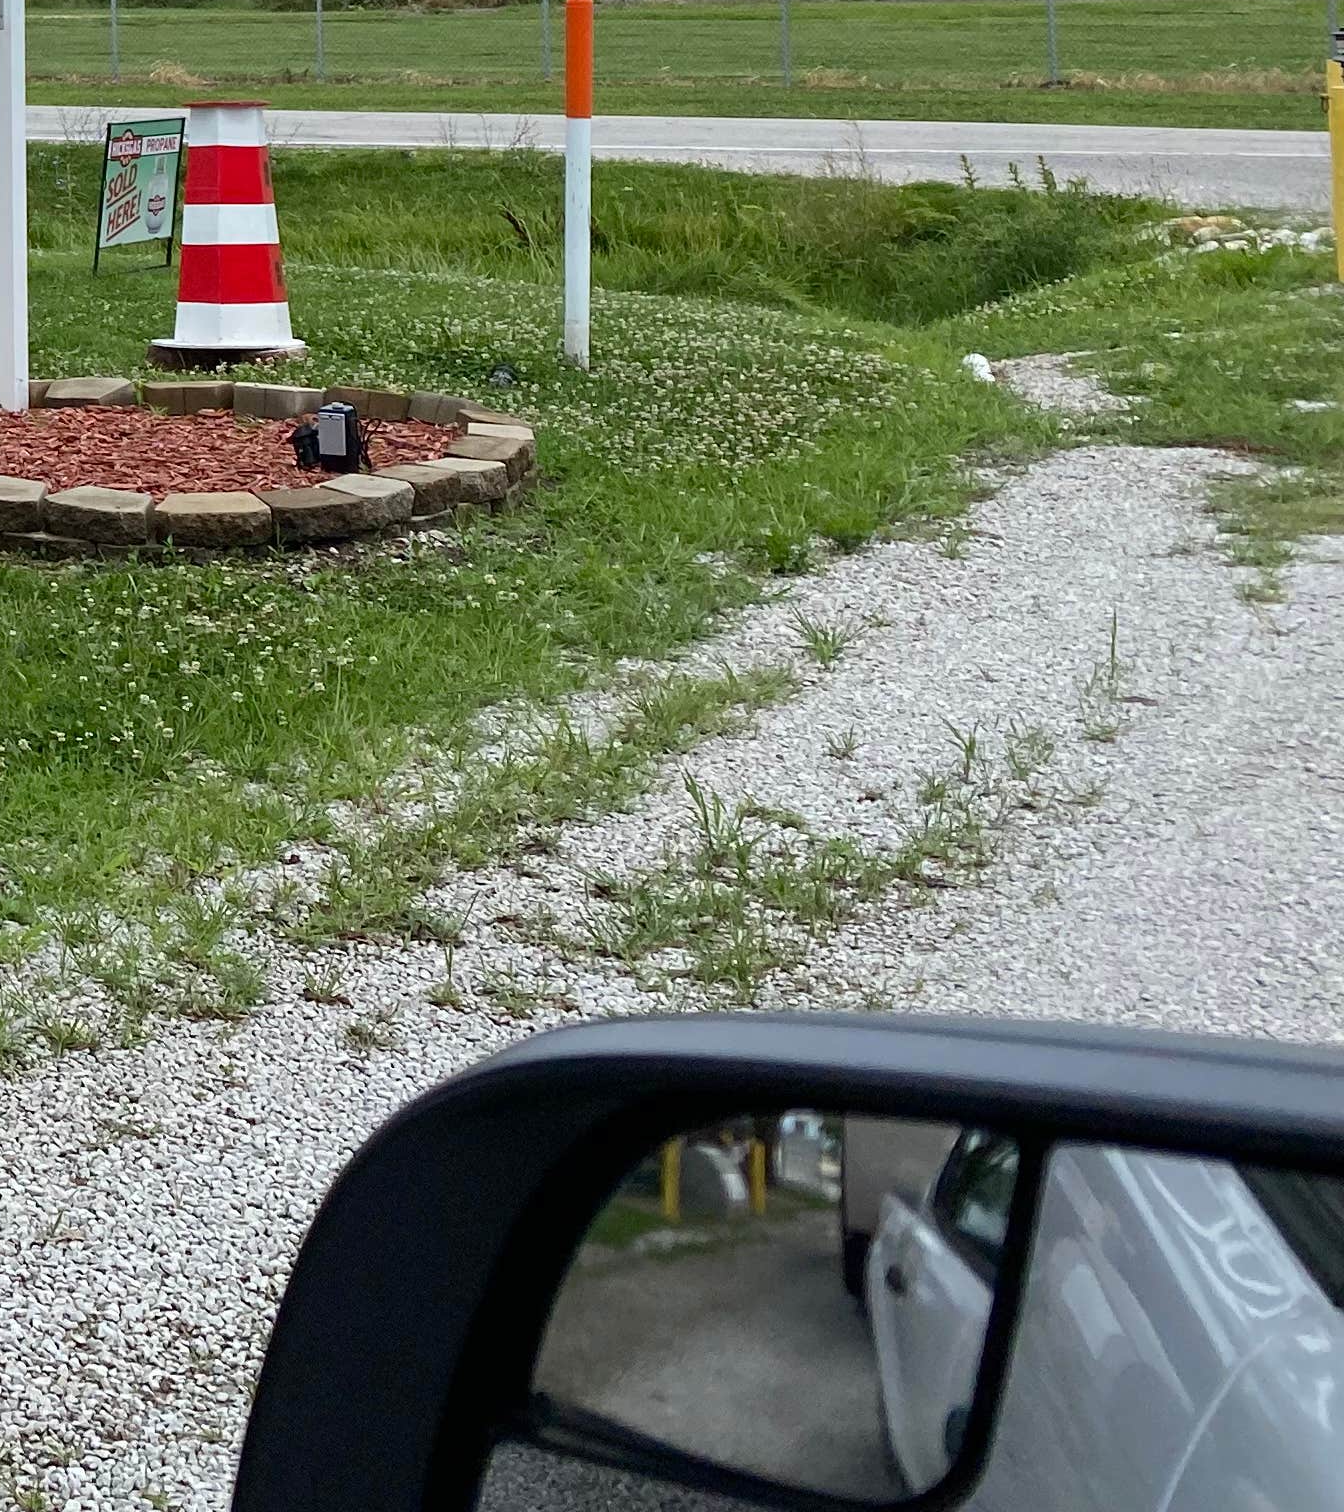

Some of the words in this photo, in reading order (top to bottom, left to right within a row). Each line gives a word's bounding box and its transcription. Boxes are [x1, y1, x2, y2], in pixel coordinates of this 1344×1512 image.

[146, 136, 178, 152] PROPANE
[106, 164, 138, 203] SOLD
[106, 190, 142, 235] HERE!
